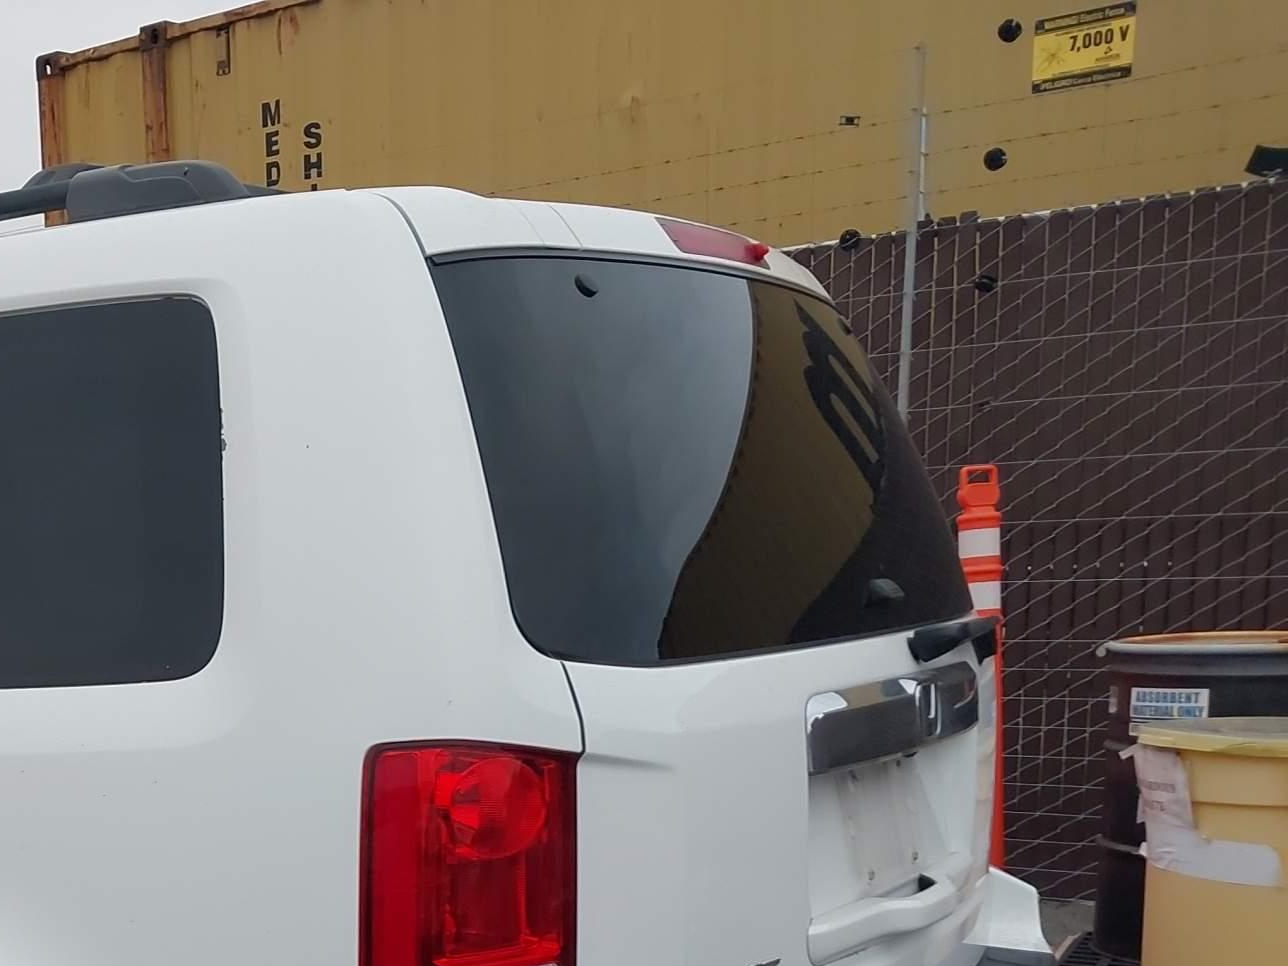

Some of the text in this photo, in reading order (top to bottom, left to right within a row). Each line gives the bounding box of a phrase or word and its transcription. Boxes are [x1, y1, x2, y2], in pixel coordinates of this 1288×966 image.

[1069, 30, 1113, 53] 7,000
[1119, 24, 1130, 42] V
[303, 122, 323, 191] SH
